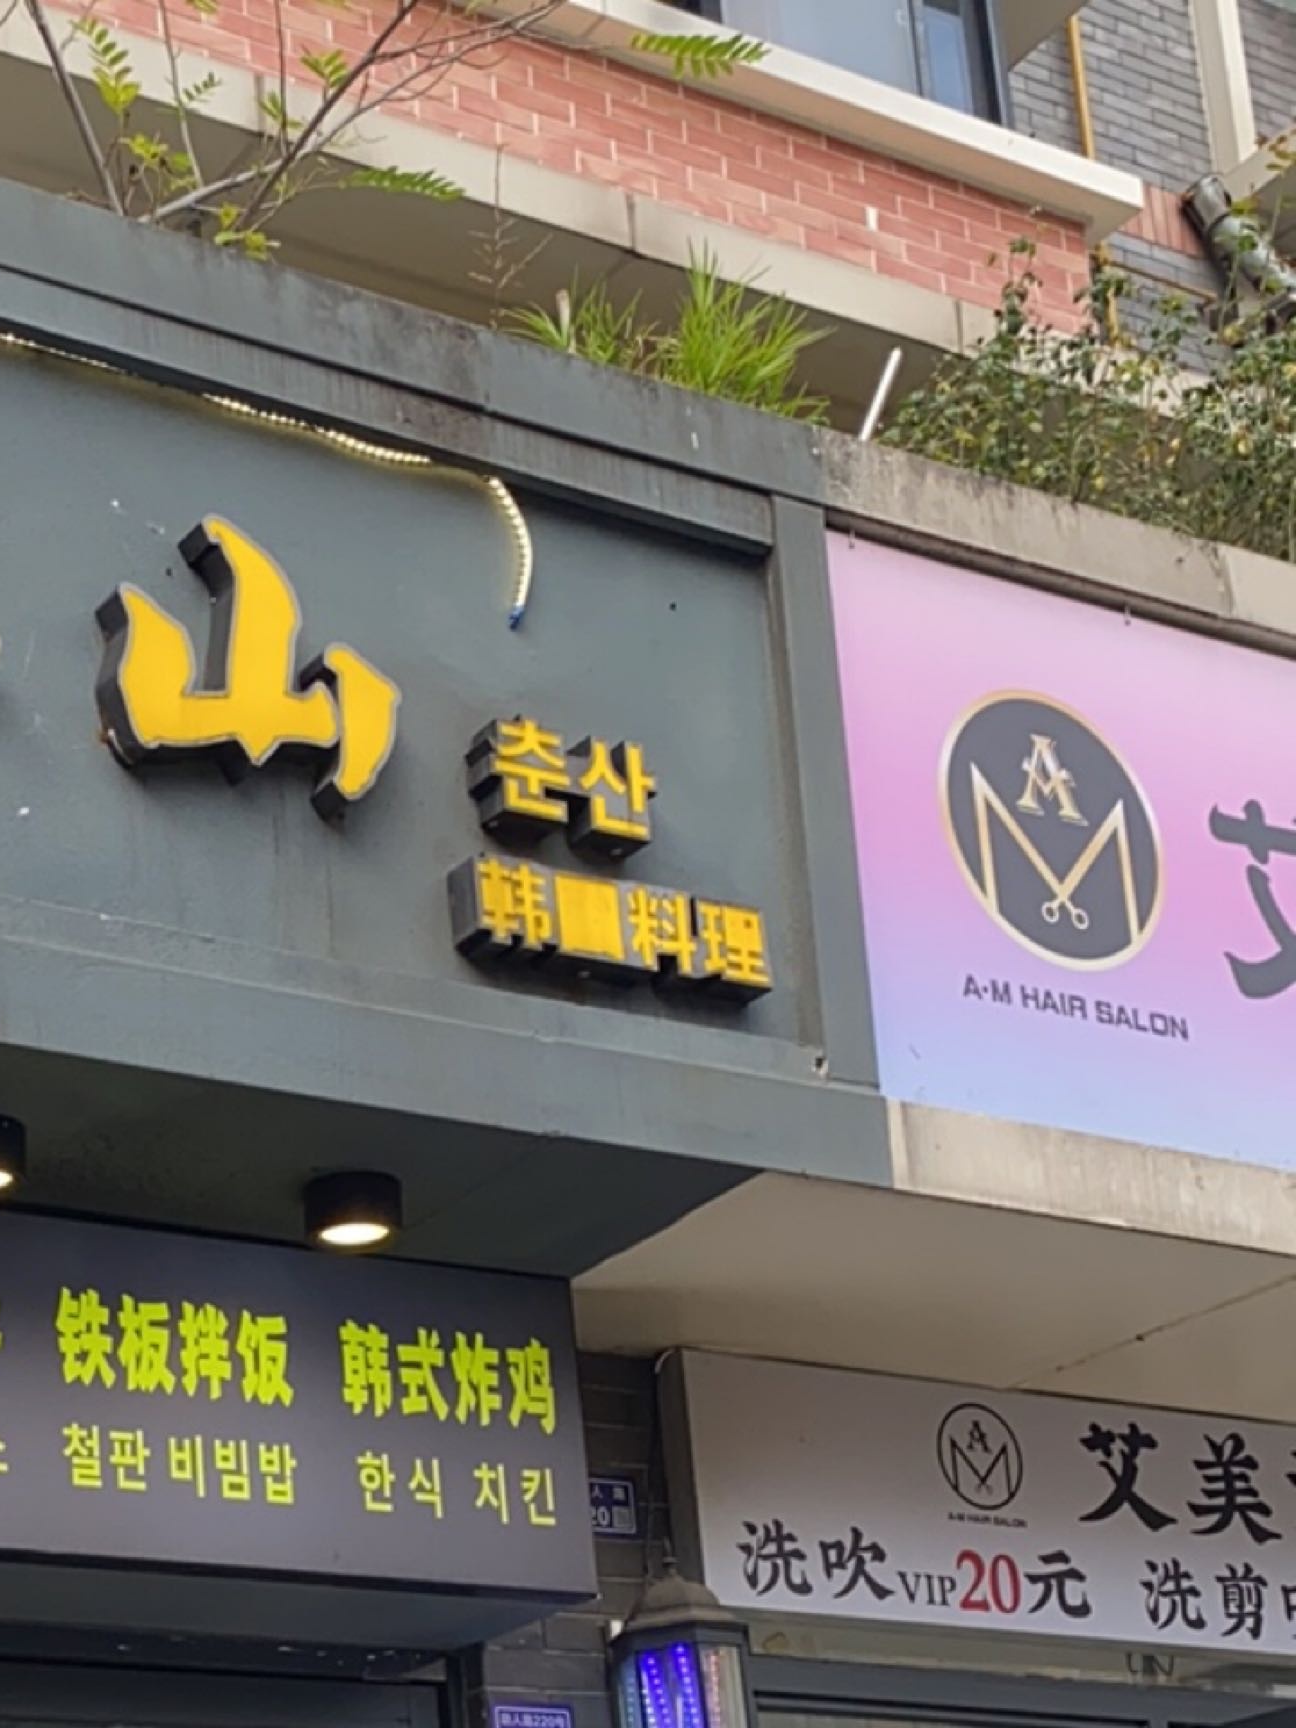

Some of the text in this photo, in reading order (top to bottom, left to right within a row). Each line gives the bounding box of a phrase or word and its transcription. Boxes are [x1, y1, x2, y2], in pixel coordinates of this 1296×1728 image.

[494, 716, 656, 838] 춘산
[478, 857, 770, 986] 韩料理
[1020, 984, 1088, 1021] HAIR
[1095, 1001, 1190, 1041] SALON
[56, 1285, 294, 1406] 铁板拌饭
[339, 1319, 556, 1435] 韩式炸鸡
[62, 1422, 149, 1491] 철판
[169, 1434, 297, 1506] 비빔밥
[357, 1450, 445, 1519] 한식
[474, 1462, 557, 1526] 치킨
[1078, 1421, 1296, 1544] 艾美
[1140, 1557, 1296, 1639] 洗剪
